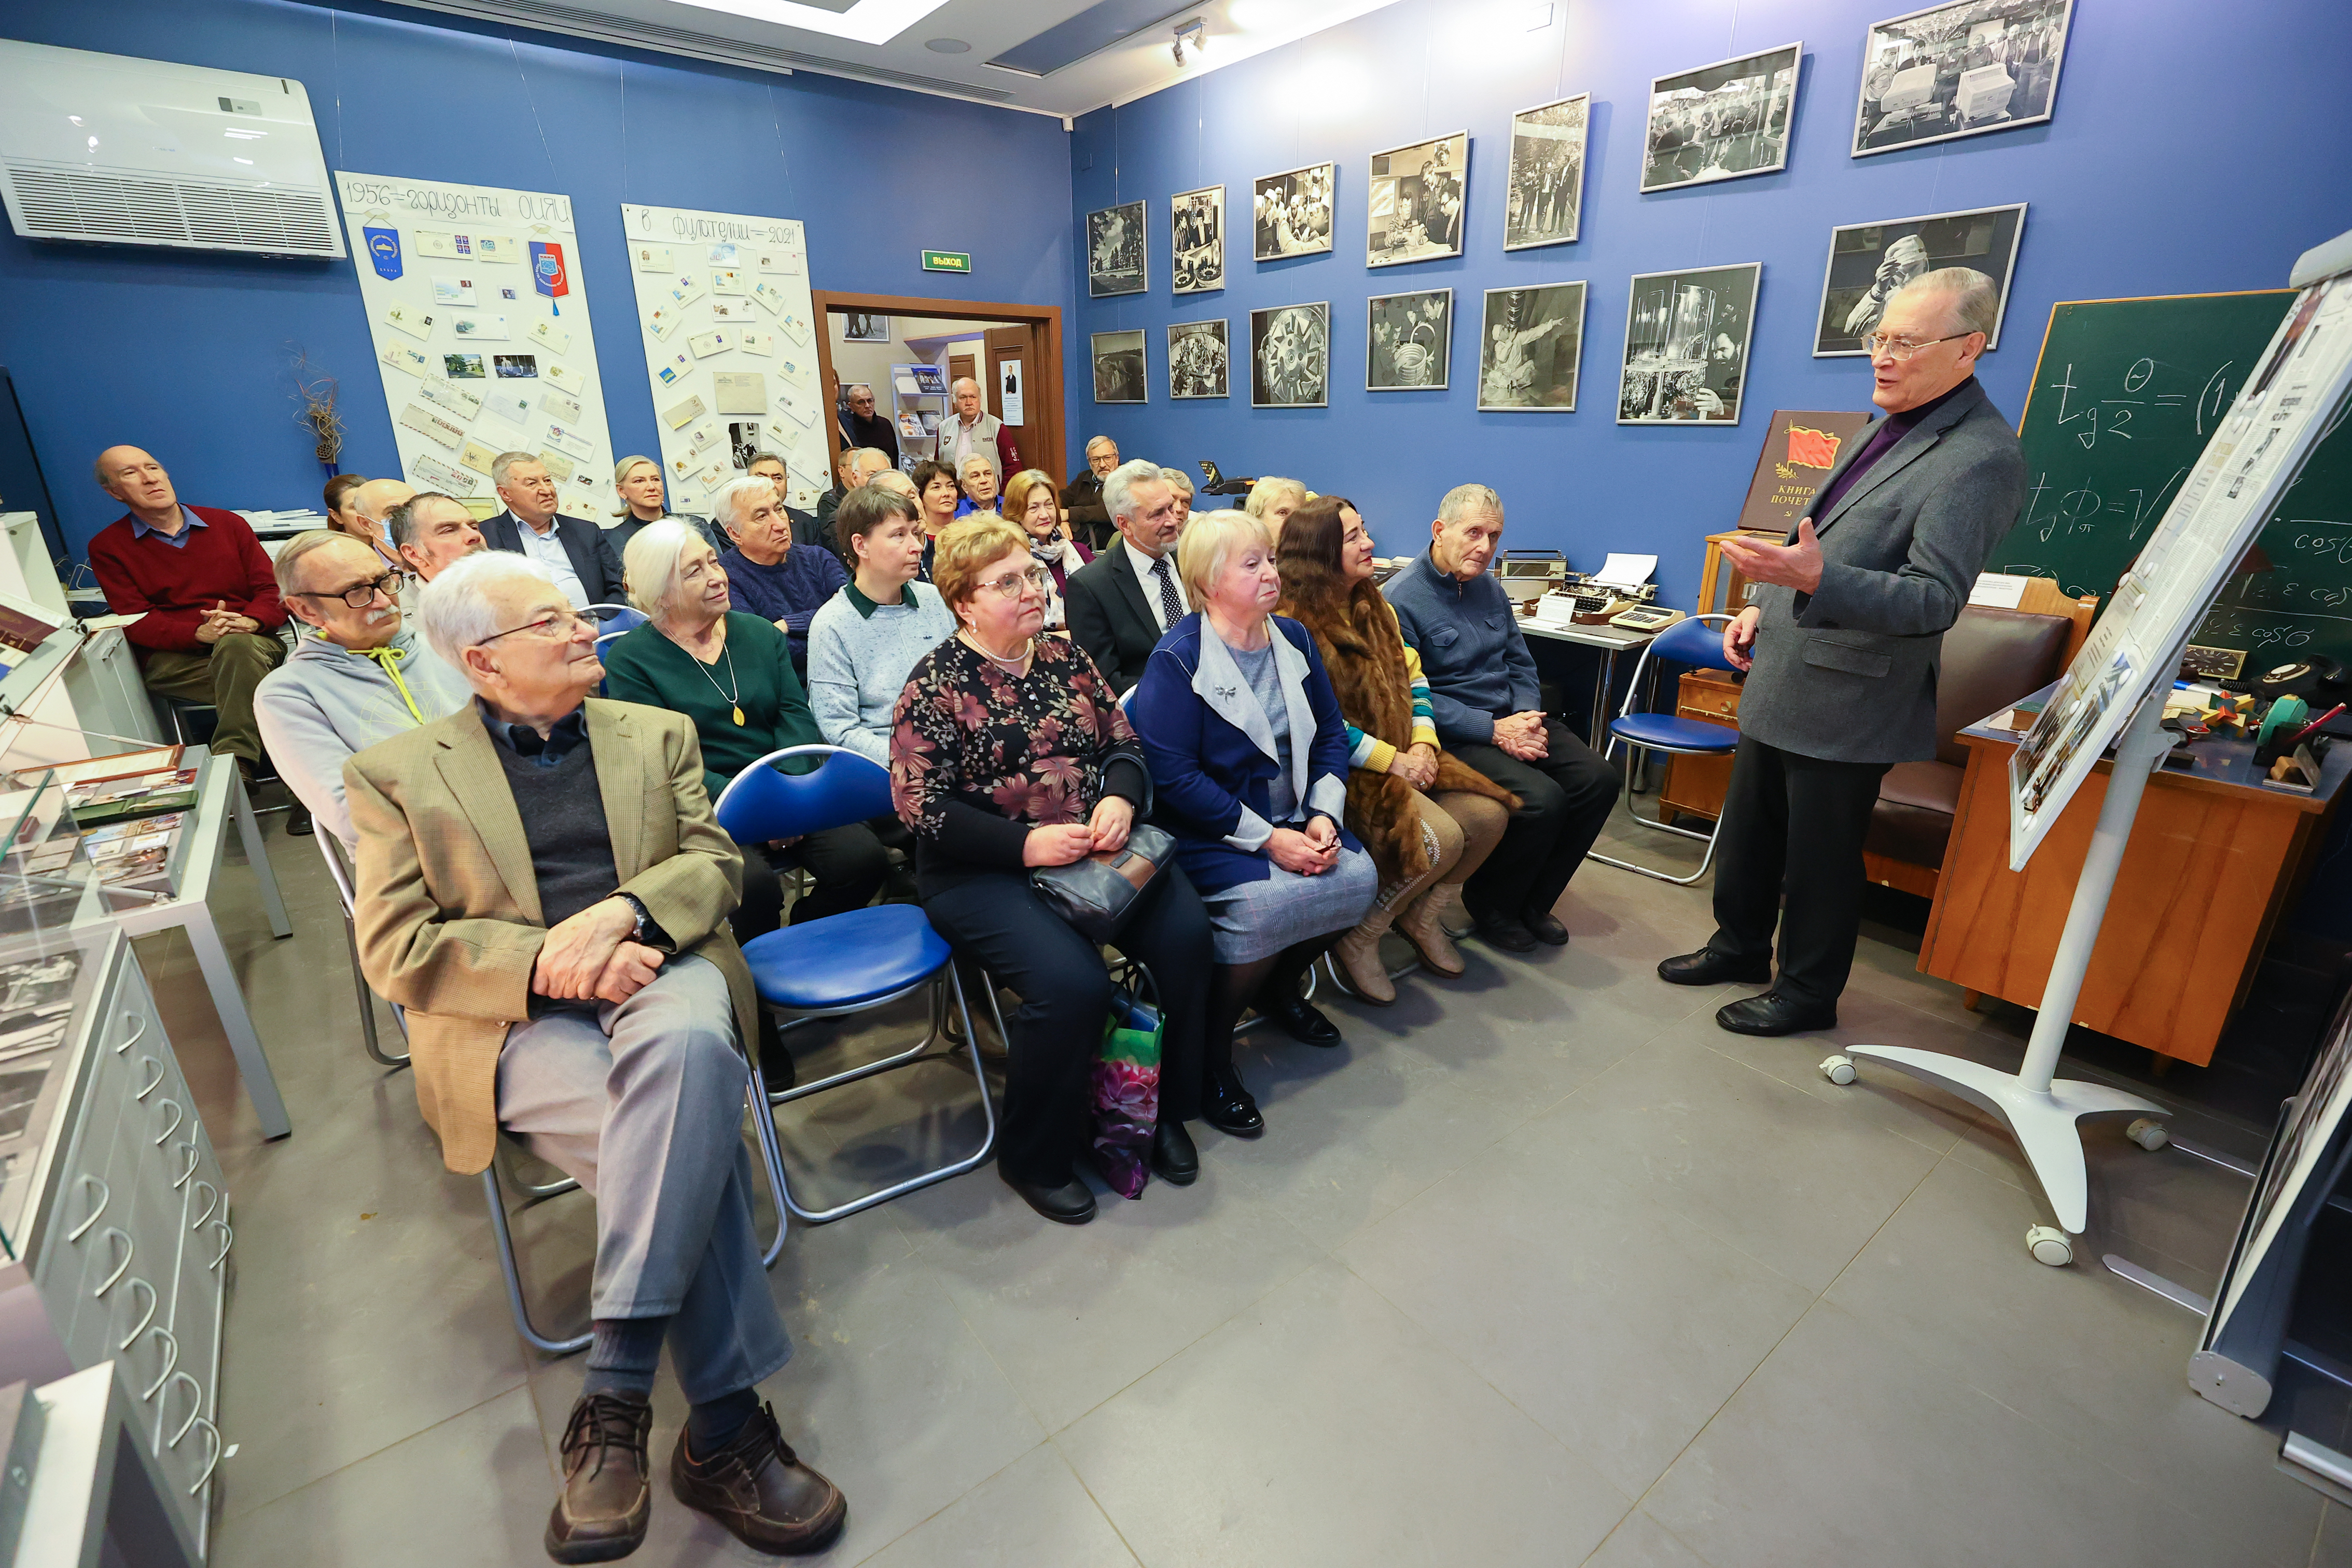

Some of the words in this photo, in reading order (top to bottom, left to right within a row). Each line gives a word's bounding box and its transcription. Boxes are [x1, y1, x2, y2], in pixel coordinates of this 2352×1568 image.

[933, 257, 962, 268] ВЫХОД
[1778, 485, 1816, 495] КНИГА
[1770, 495, 1811, 506] ПОЧЕТ
